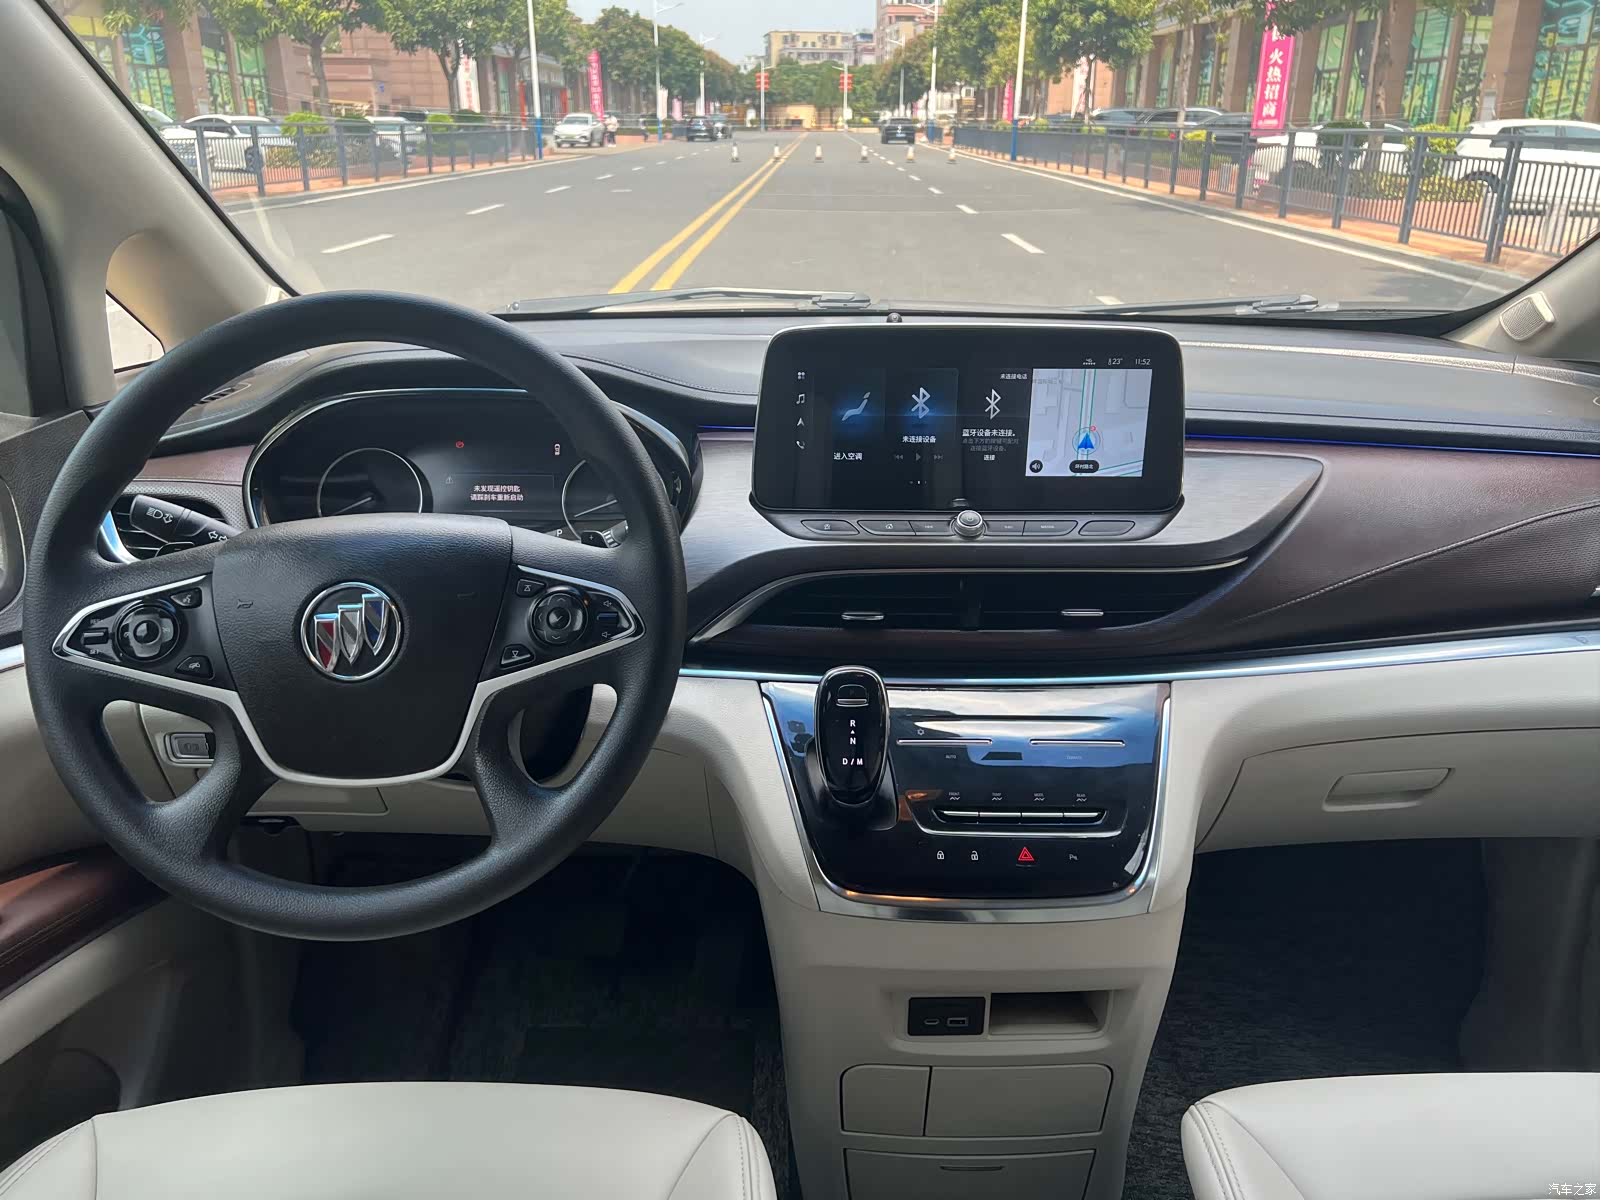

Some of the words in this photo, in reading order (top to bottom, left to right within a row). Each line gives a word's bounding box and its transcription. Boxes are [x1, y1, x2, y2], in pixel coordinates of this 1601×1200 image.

[1135, 358, 1151, 366] 11:52
[902, 435, 936, 443] 未连接设备
[833, 452, 863, 461] 进入空调
[470, 493, 524, 501] 请踩刹车重新启动
[556, 529, 563, 537] P
[850, 719, 856, 727] R
[849, 737, 857, 745] N
